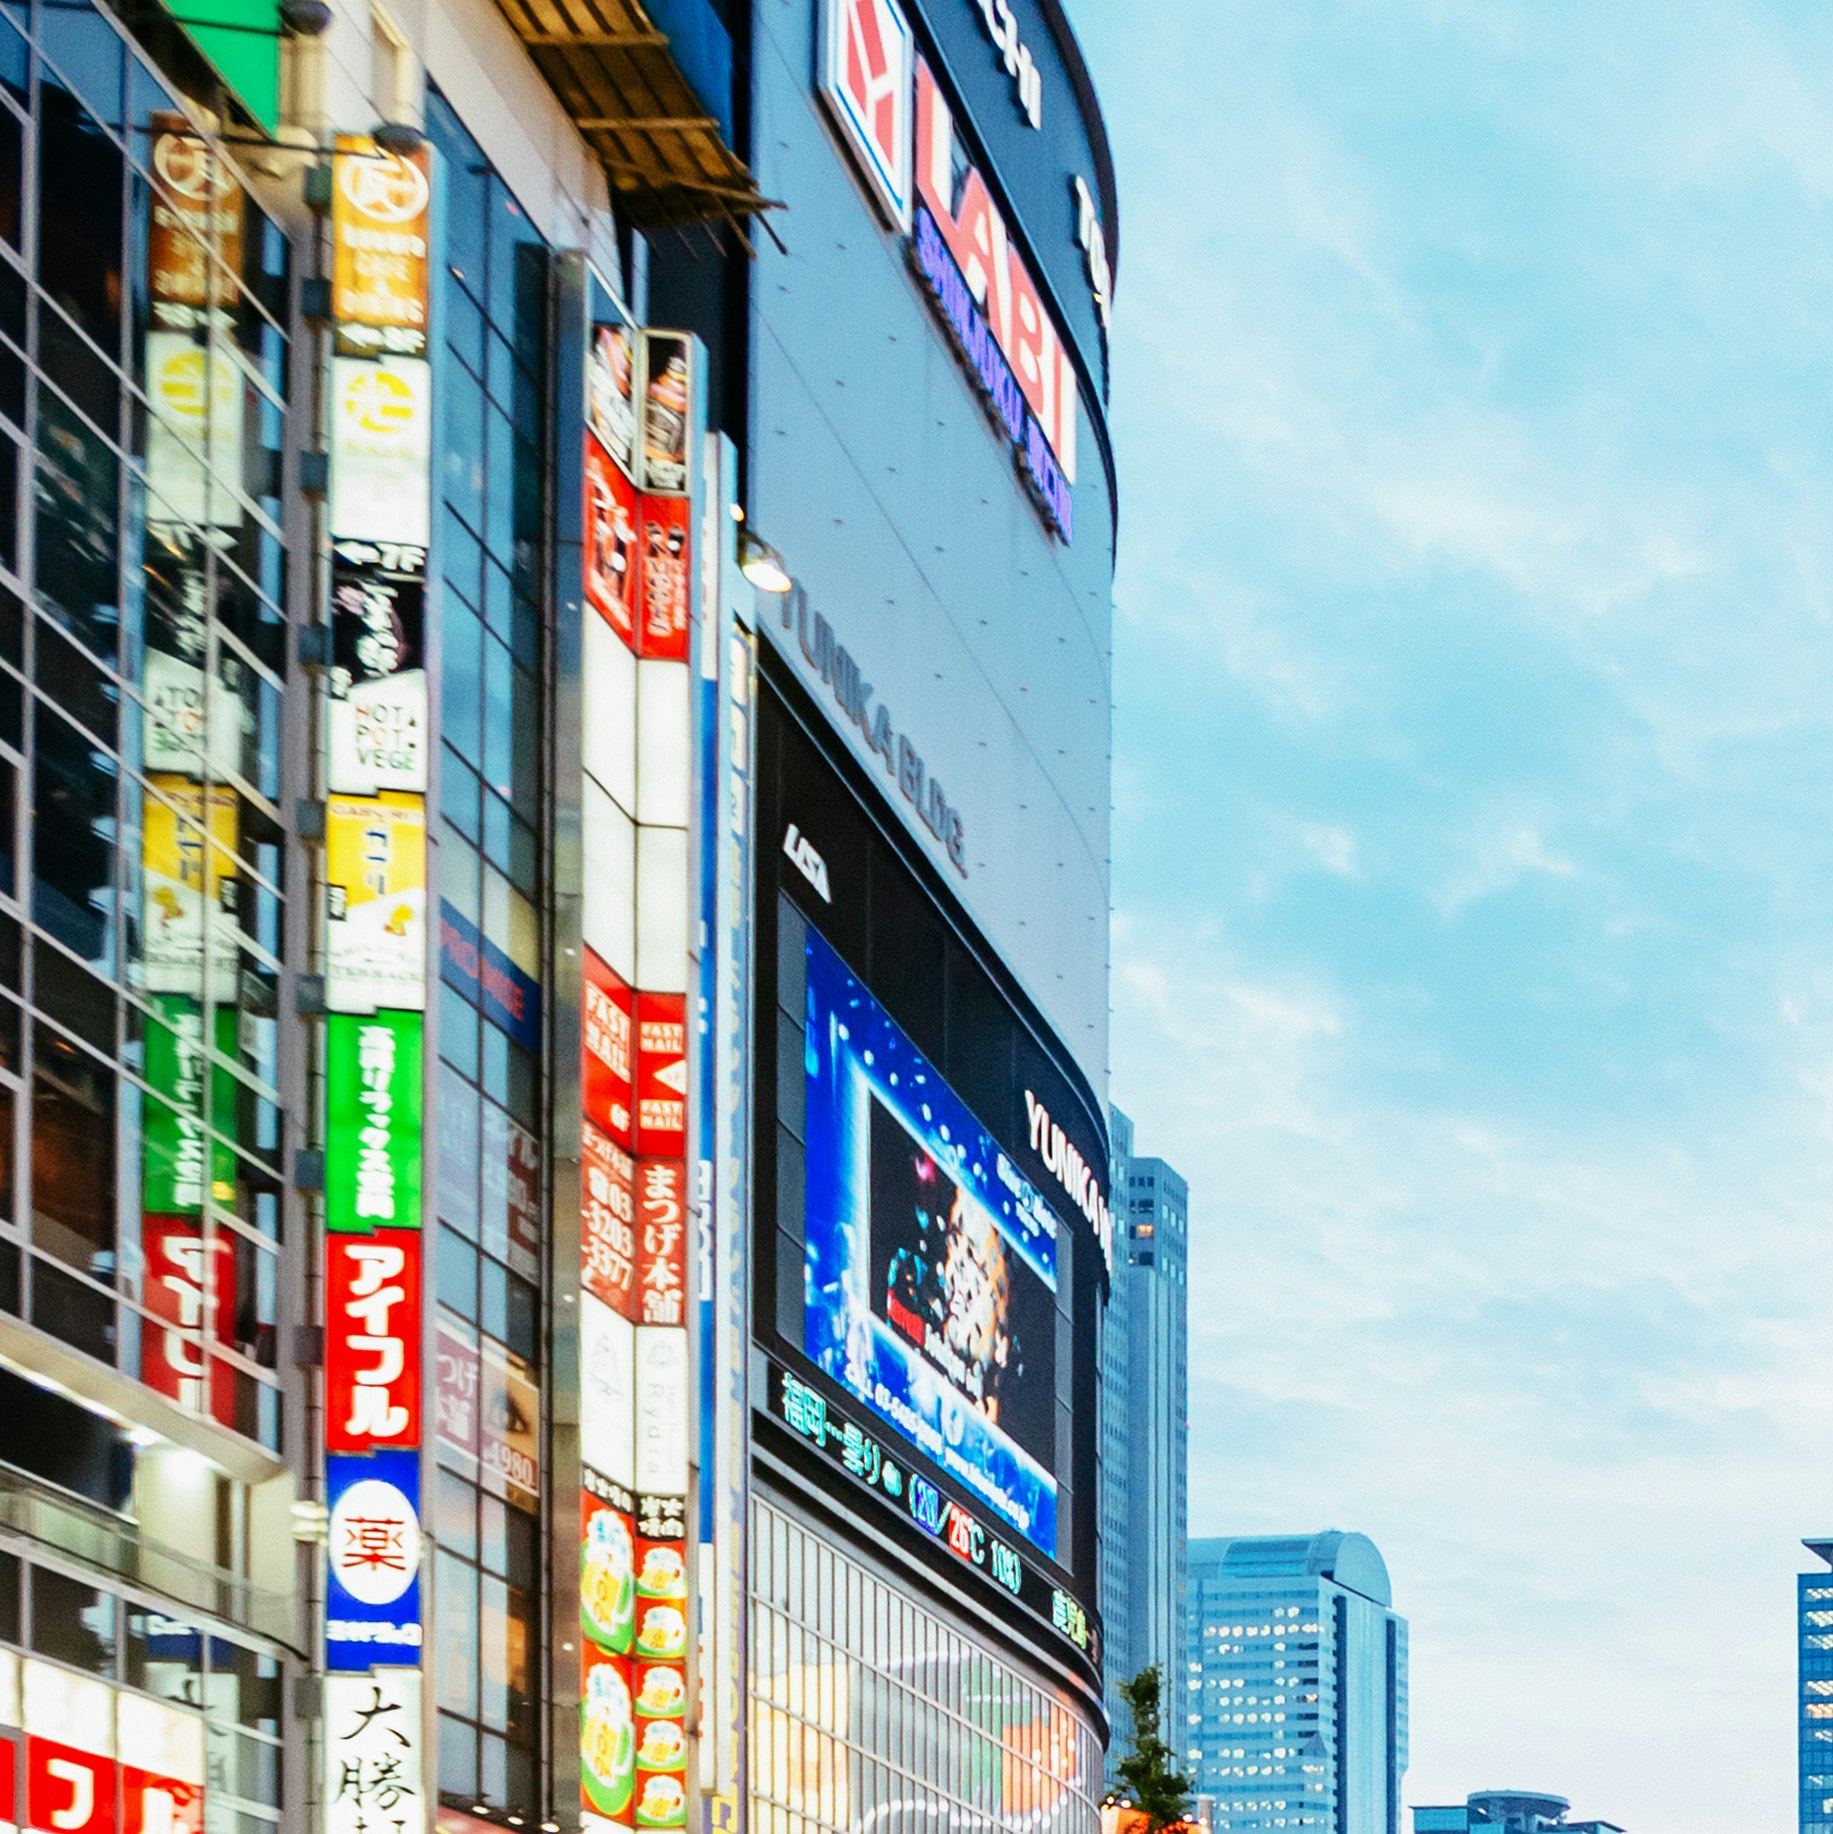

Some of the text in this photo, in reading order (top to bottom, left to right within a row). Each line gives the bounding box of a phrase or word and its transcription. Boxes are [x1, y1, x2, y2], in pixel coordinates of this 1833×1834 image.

[914, 52, 1077, 488] LABI
[642, 1165, 683, 1322] まつげ本舗
[345, 1243, 411, 1437] アイフル
[343, 1516, 406, 1572] 薬
